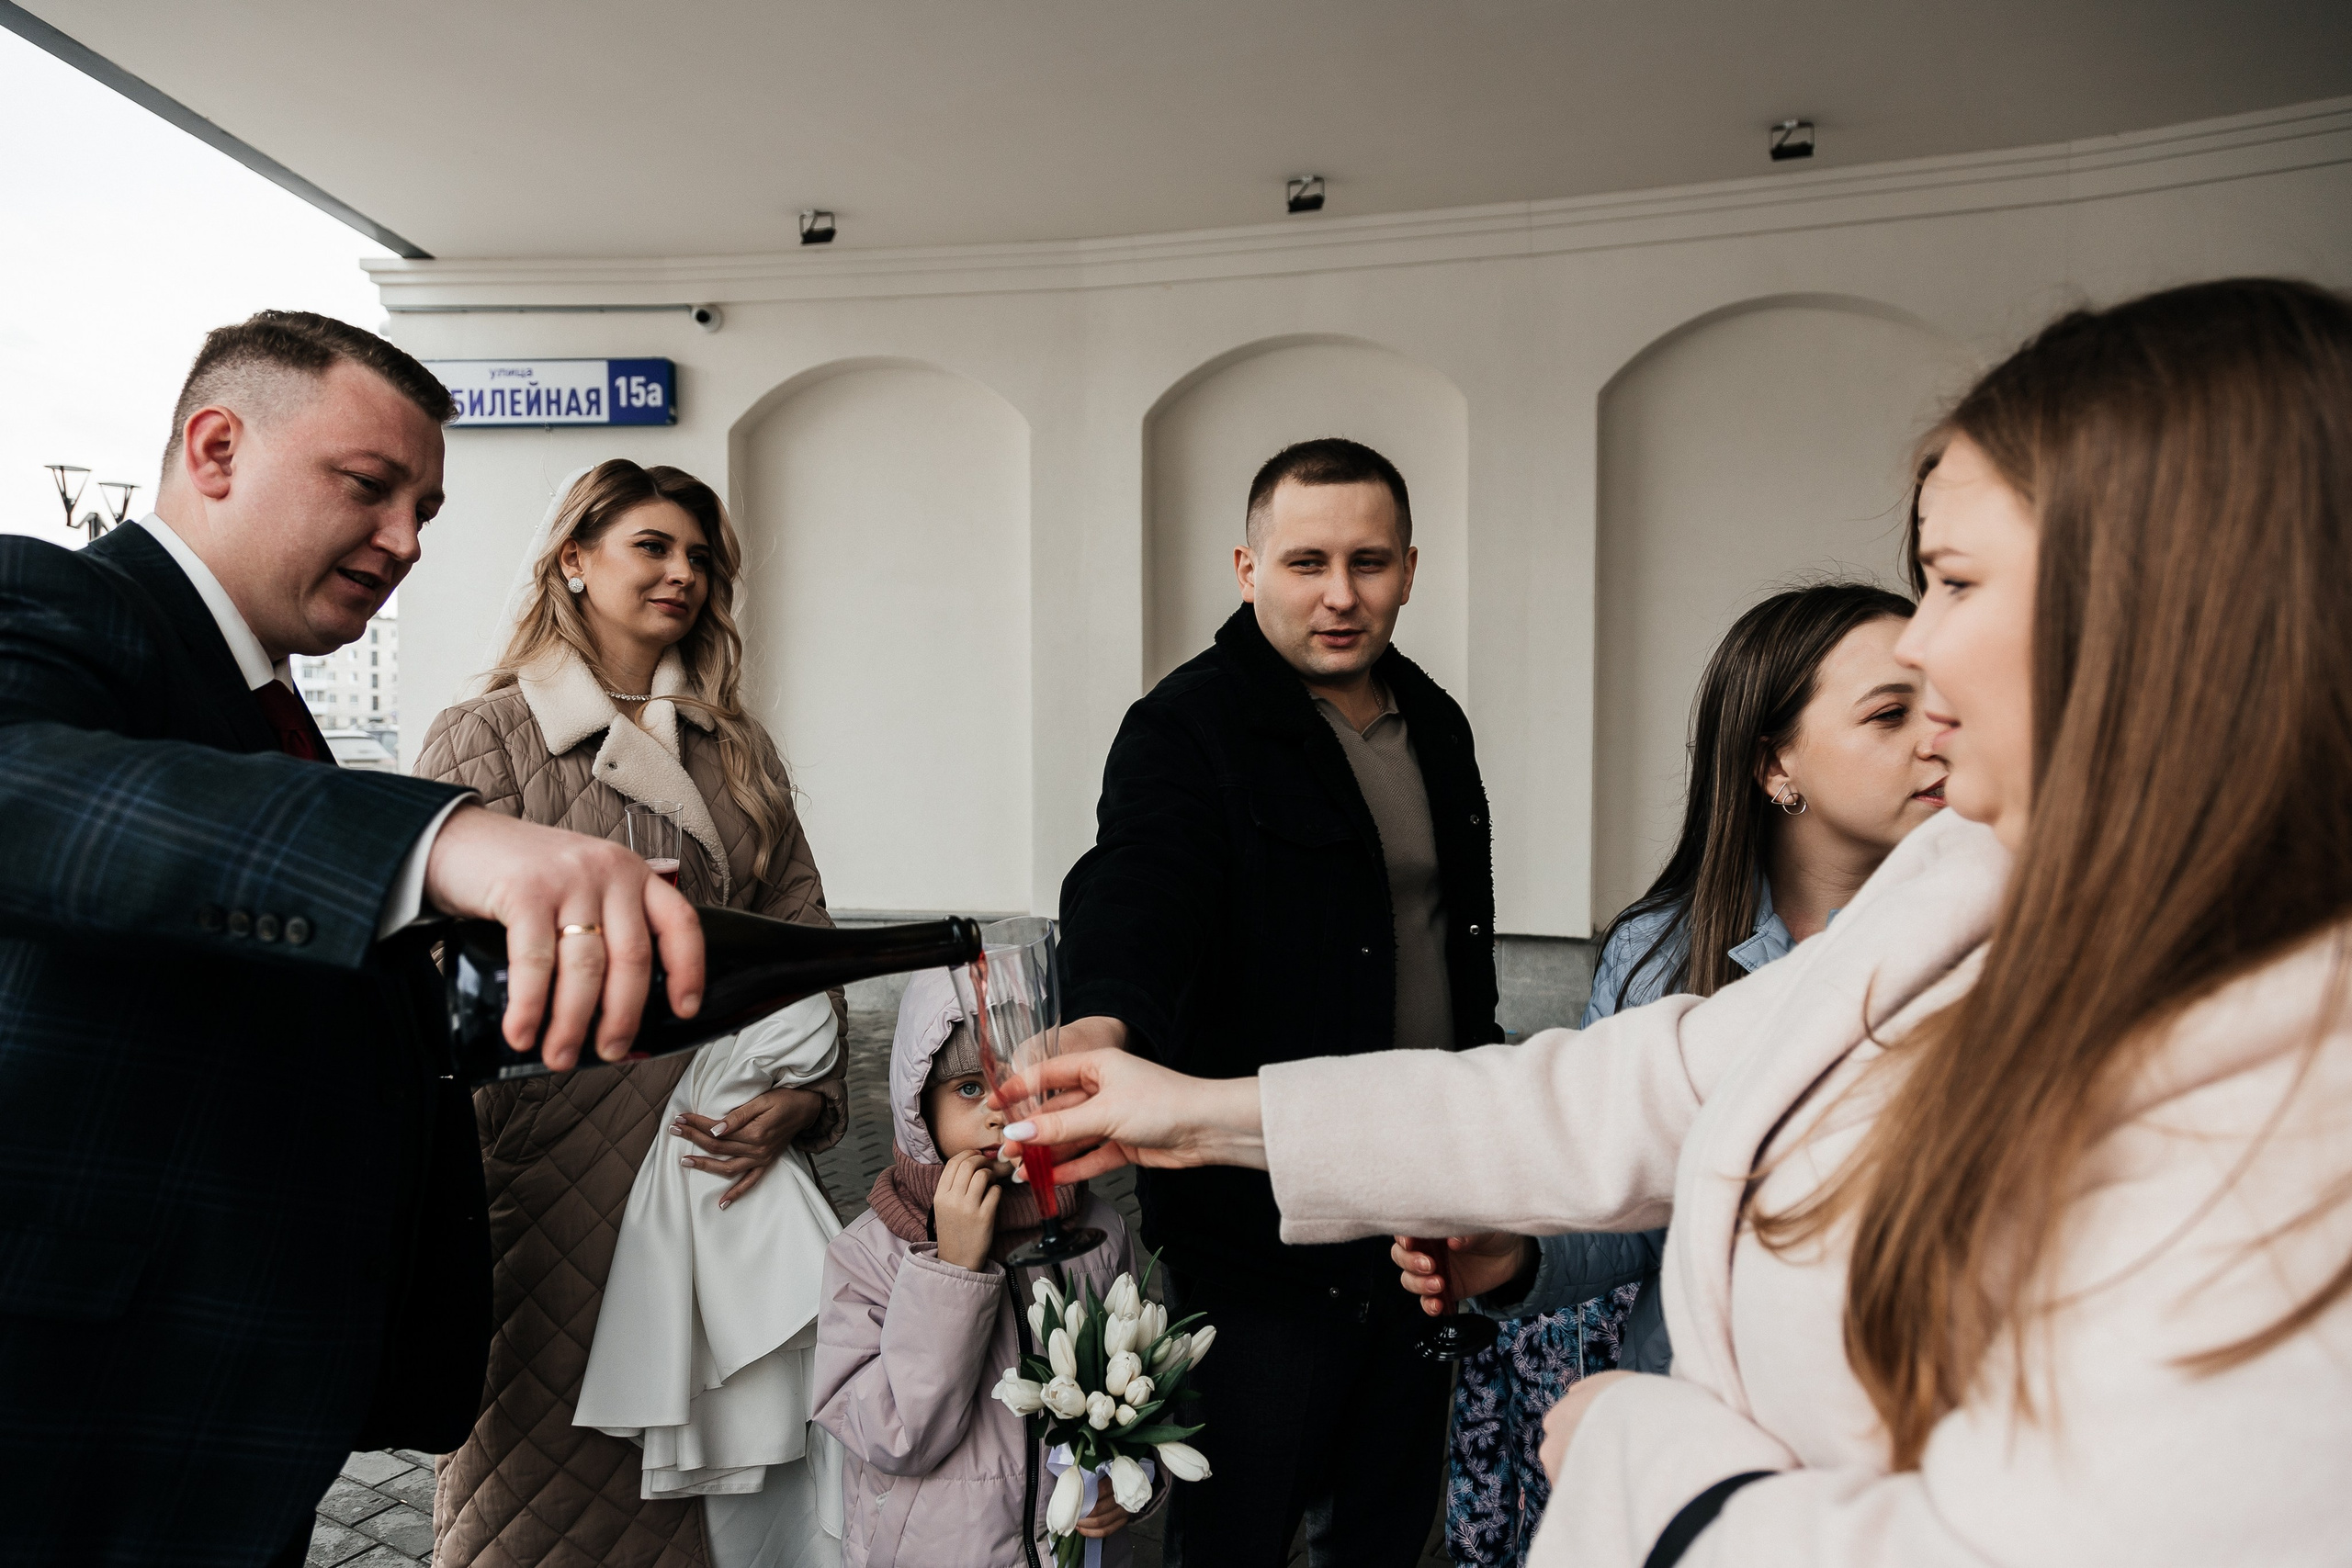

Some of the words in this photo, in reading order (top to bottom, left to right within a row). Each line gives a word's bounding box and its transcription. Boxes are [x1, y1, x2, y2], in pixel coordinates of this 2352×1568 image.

[490, 367, 533, 378] улица
[451, 382, 601, 416] БИЛЕЙНАЯ
[615, 376, 663, 407] 15а
